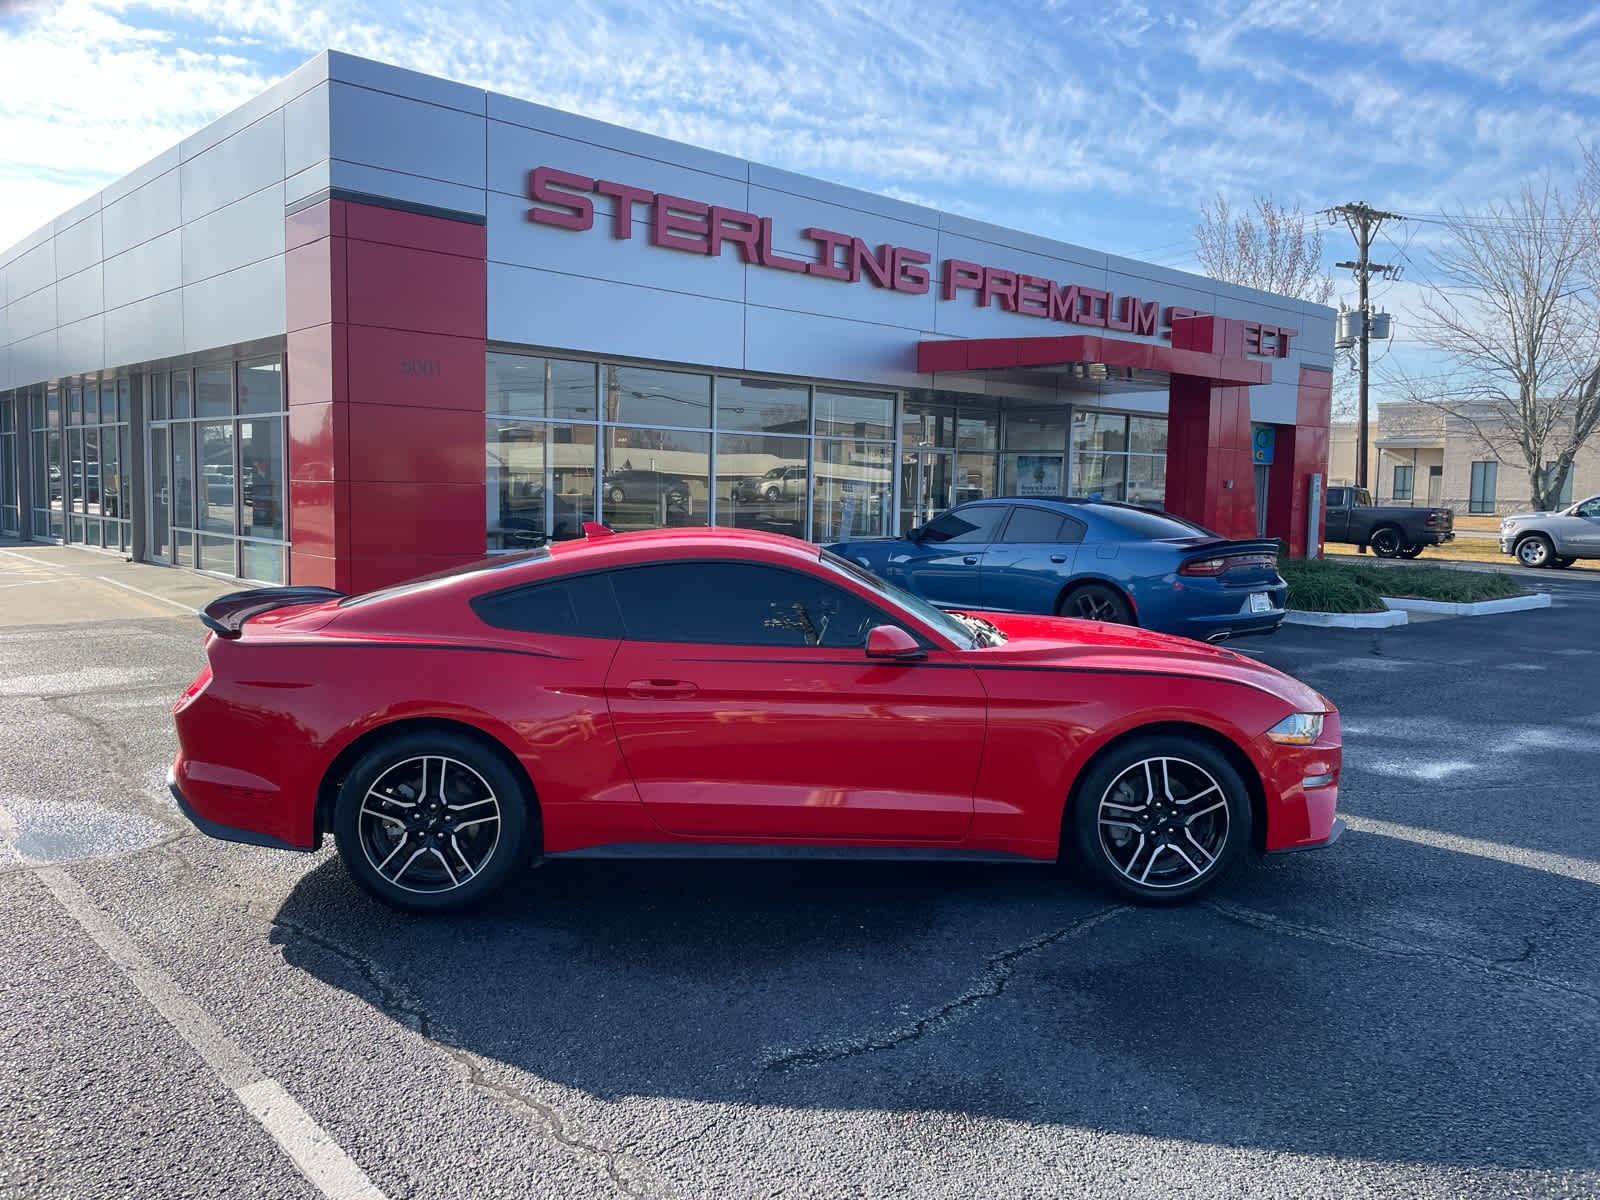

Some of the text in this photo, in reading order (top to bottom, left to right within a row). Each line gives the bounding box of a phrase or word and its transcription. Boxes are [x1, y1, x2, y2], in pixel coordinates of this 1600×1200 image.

[527, 166, 1298, 359] STERLING PREMIUM SECT
